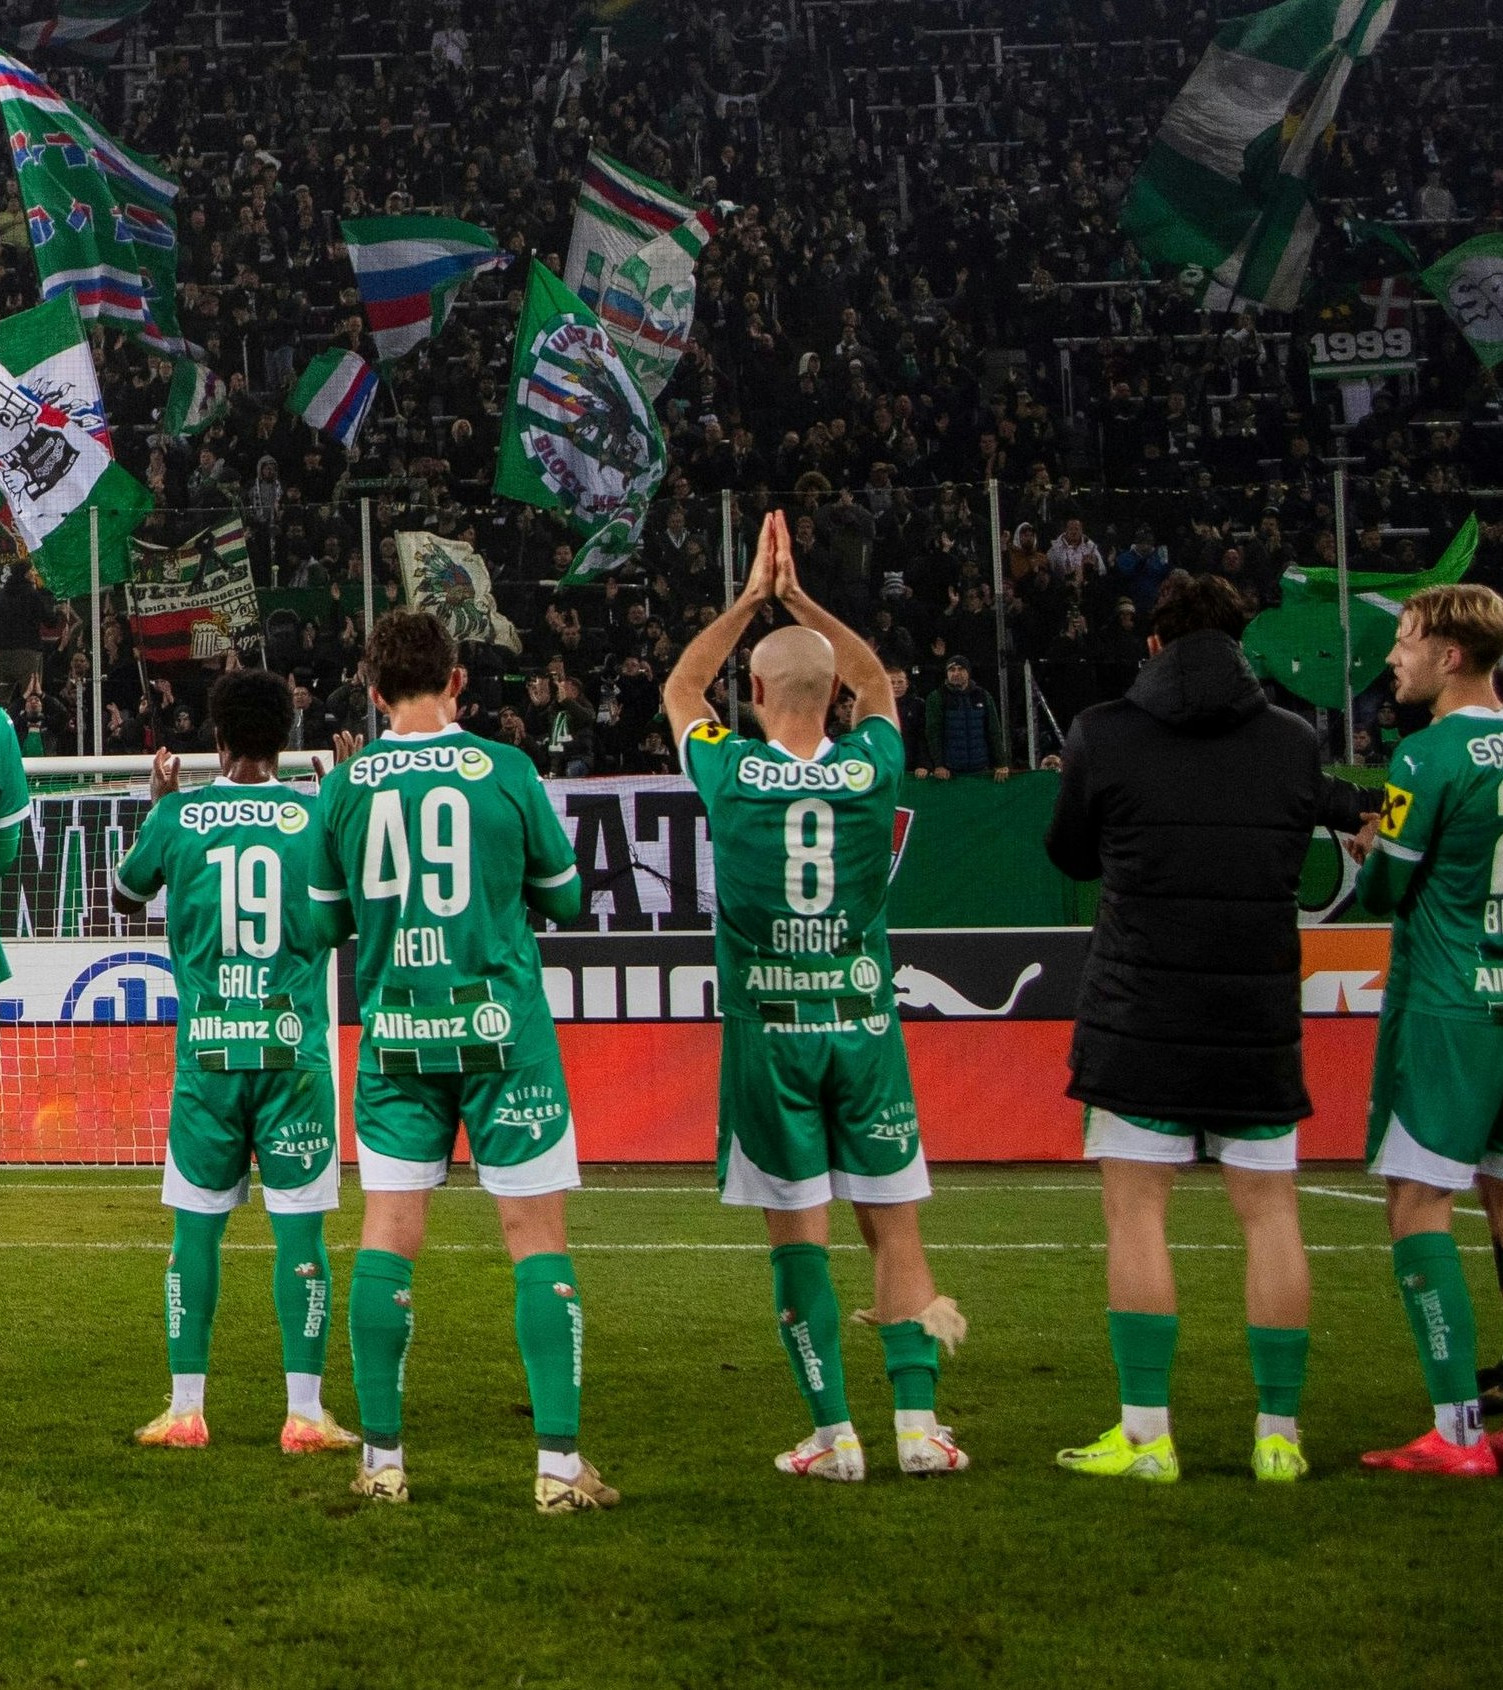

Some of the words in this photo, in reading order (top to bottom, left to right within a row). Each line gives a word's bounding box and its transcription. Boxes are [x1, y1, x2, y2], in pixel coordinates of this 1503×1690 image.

[1310, 327, 1412, 363] 1999
[350, 748, 455, 785] spusu
[739, 757, 847, 790] spusu
[180, 802, 277, 834] spusu
[363, 786, 470, 917] 49
[784, 798, 834, 915] 8
[206, 845, 281, 959] 19
[772, 910, 848, 953] GRGIĆ
[219, 964, 270, 999] GALE
[746, 965, 845, 991] Allianz
[189, 1016, 270, 1042] Allianz
[372, 1012, 468, 1040] Allianz
[505, 1085, 554, 1104] WIENER
[494, 1103, 563, 1127] ZUCKER
[303, 1278, 326, 1339] easystaff
[789, 1320, 825, 1392] easystaff
